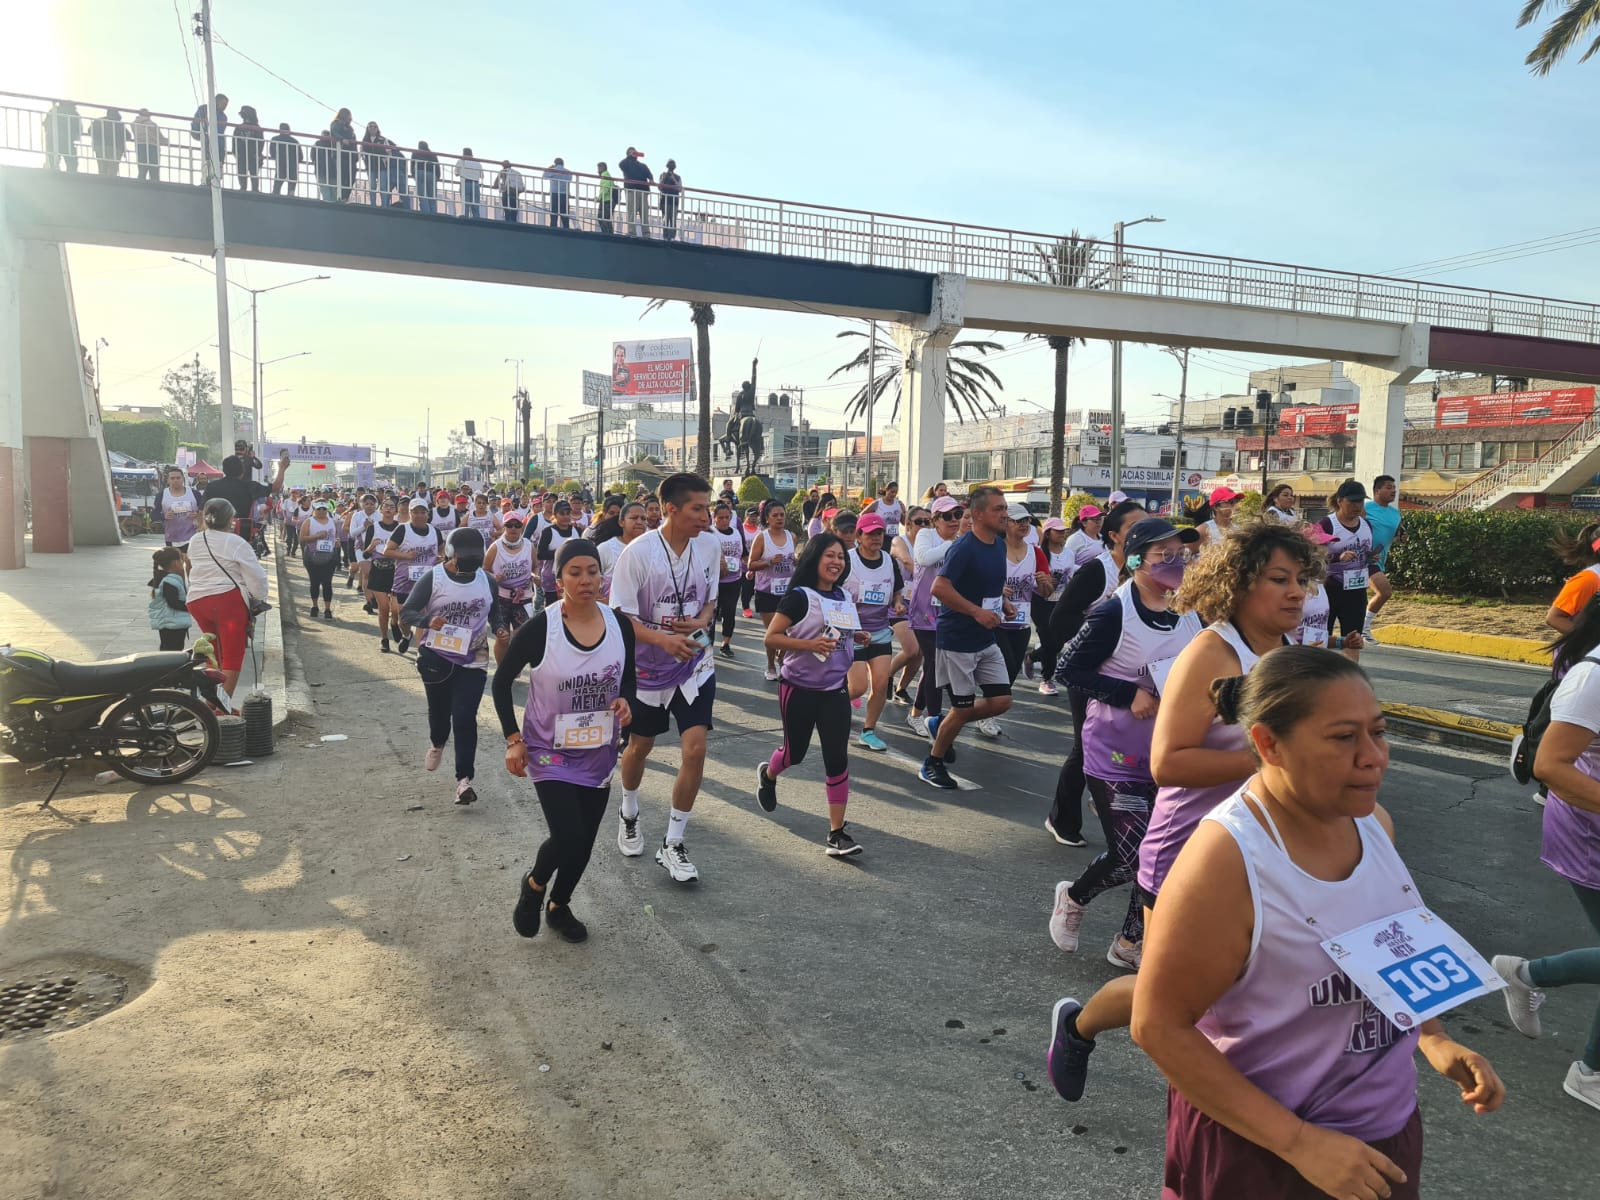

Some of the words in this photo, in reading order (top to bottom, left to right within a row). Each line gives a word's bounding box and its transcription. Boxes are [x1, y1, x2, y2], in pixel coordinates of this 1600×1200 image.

[647, 364, 655, 372] EL
[655, 362, 673, 371] MEJOR
[633, 372, 657, 381] SERVICIO
[646, 381, 659, 389] ALTA
[297, 445, 332, 455] META
[864, 592, 884, 602] 409
[558, 672, 599, 692] UNIDAS
[574, 687, 608, 696] HASTA
[609, 685, 618, 693] LA
[571, 694, 607, 711] META
[567, 728, 600, 744] 569
[1373, 929, 1395, 948] UNIDAS
[1389, 944, 1416, 958] META
[1387, 951, 1470, 1003] 103
